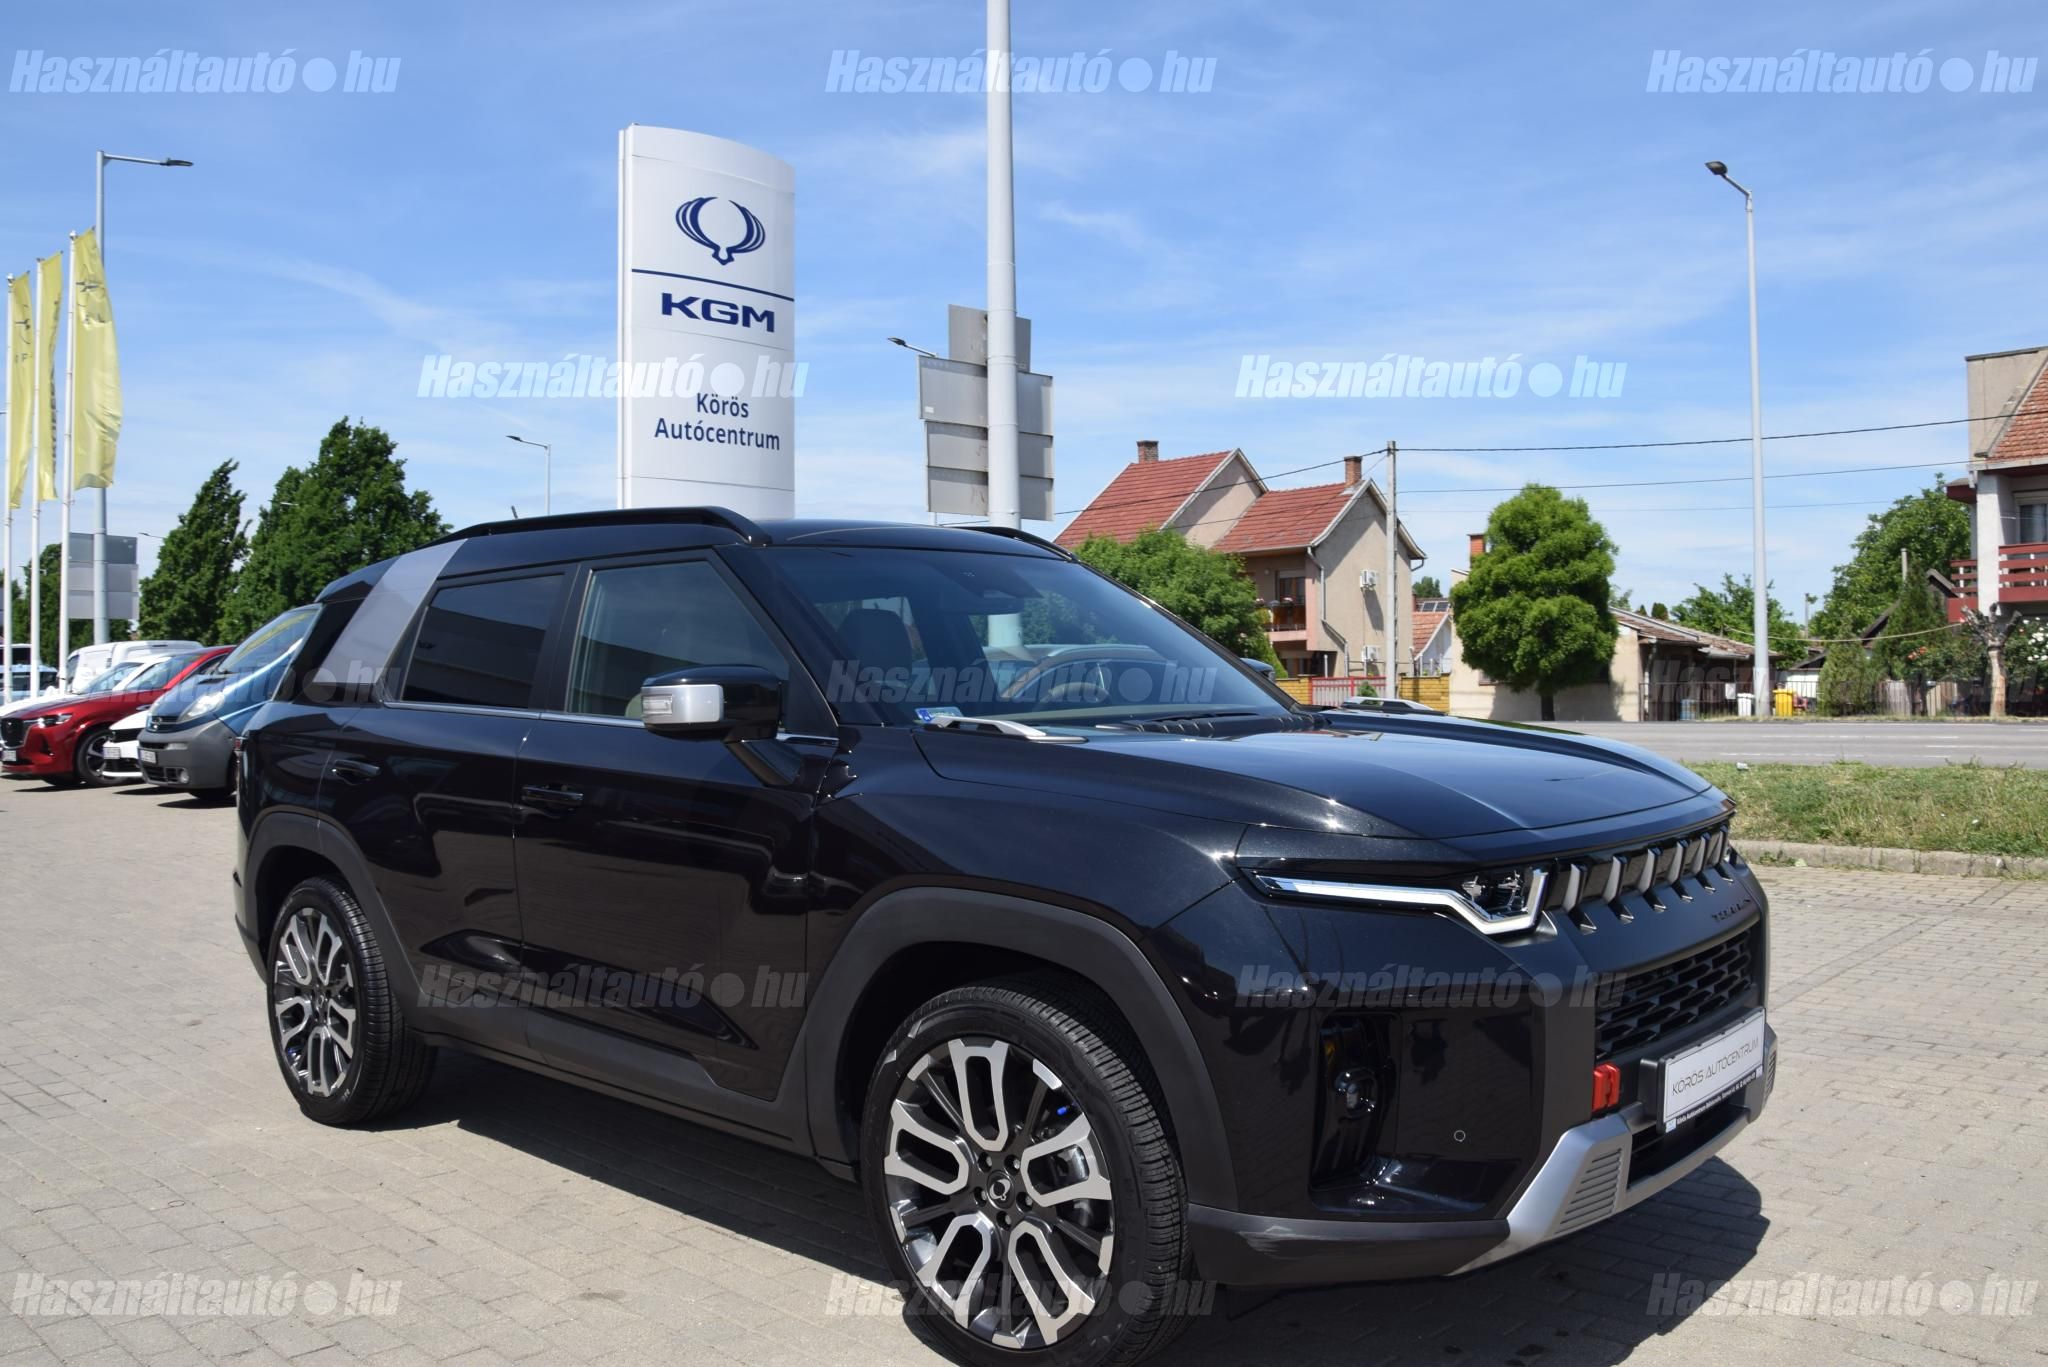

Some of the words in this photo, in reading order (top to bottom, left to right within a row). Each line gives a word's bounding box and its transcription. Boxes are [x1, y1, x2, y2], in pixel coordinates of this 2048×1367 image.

[662, 292, 775, 333] KGM
[696, 392, 749, 418] Körös
[654, 418, 780, 451] Autócentrum
